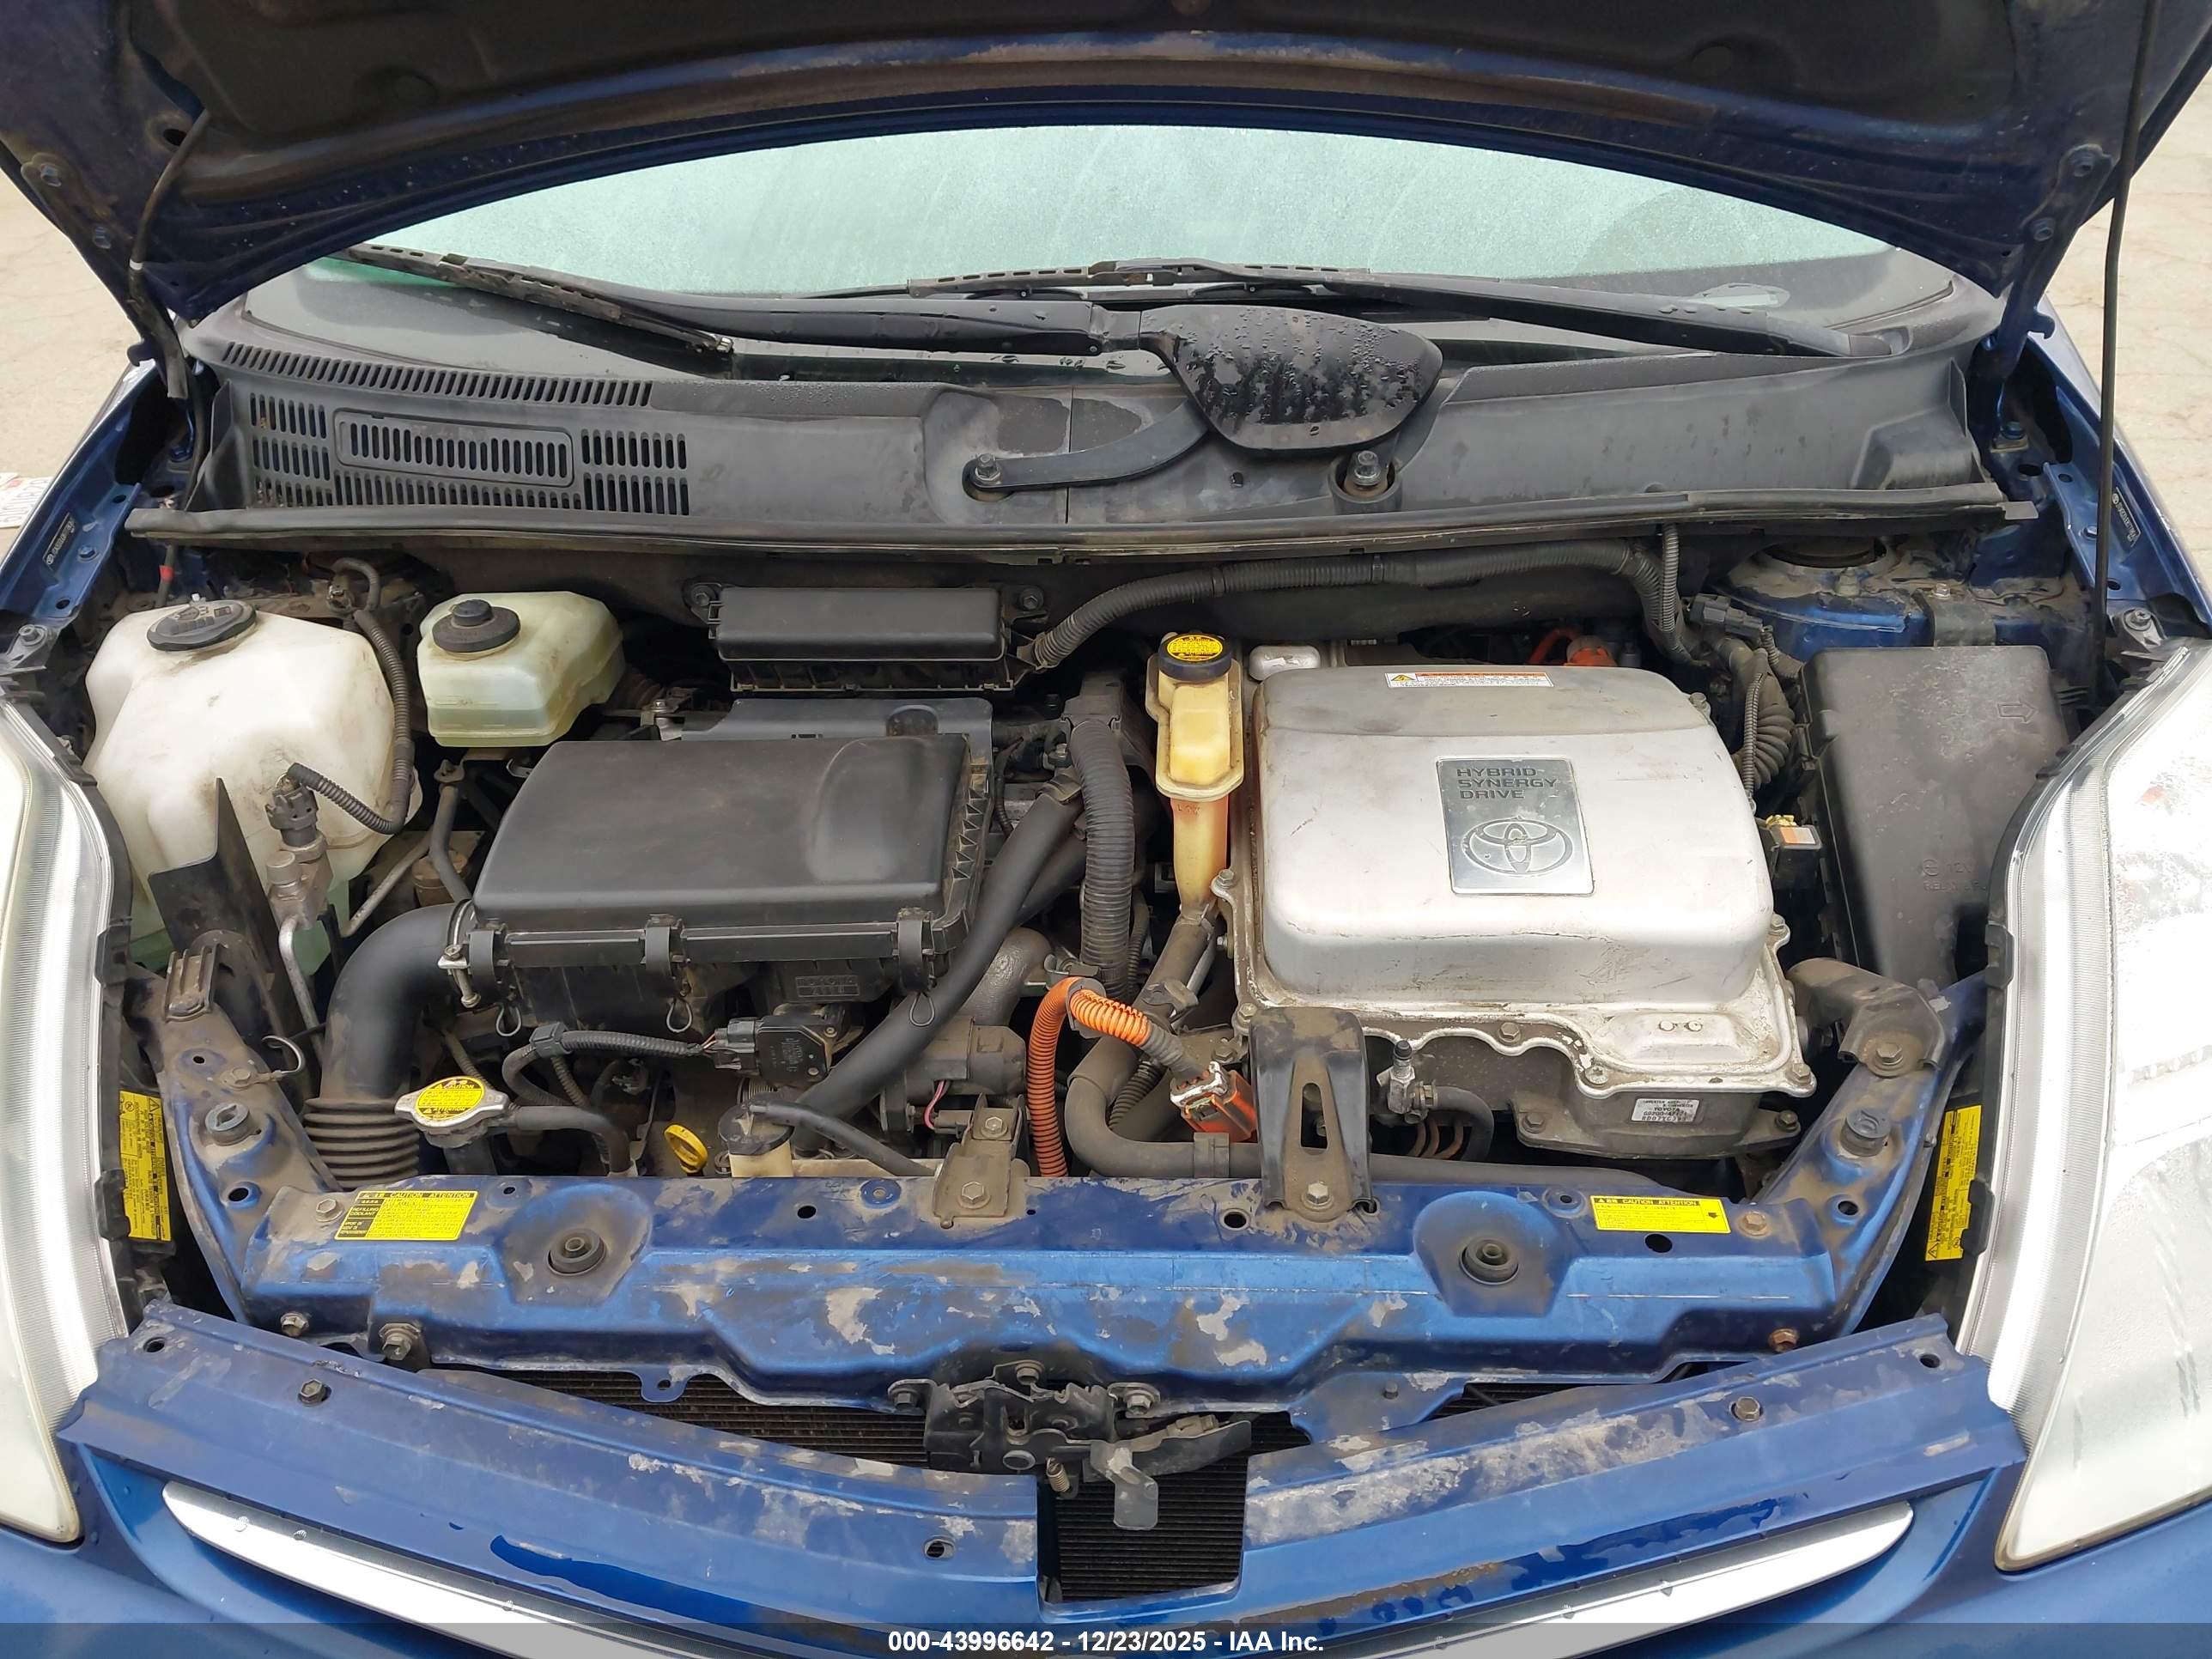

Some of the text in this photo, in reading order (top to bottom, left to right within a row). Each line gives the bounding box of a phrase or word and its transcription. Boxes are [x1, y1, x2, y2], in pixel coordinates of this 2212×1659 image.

[1456, 768, 1537, 777] HYBRID
[1457, 779, 1557, 788] SYNERGY
[1460, 789, 1525, 799] DRIVE
